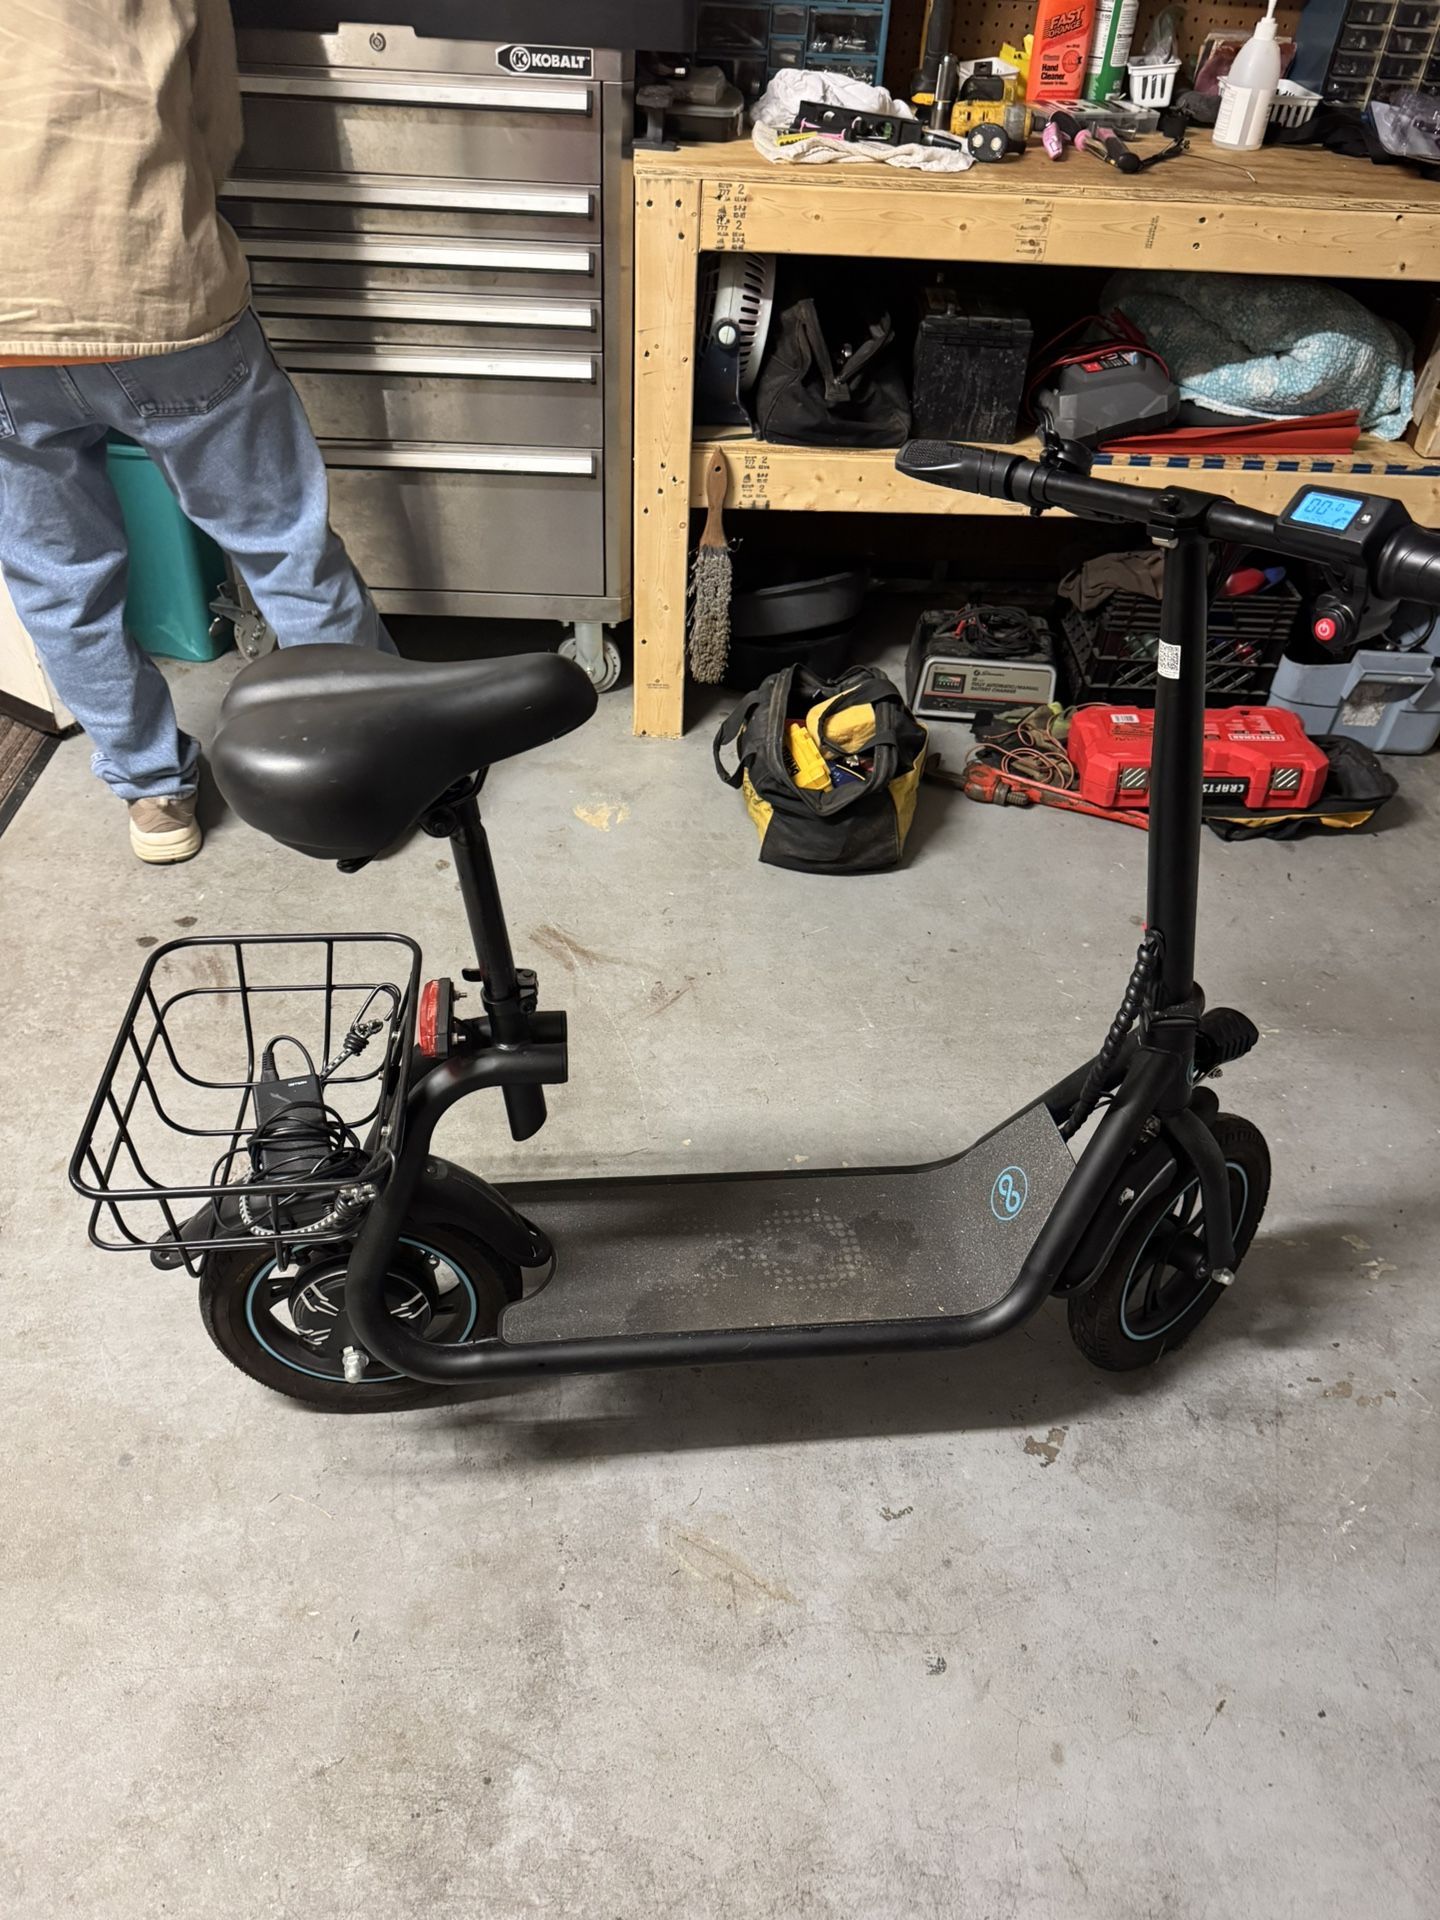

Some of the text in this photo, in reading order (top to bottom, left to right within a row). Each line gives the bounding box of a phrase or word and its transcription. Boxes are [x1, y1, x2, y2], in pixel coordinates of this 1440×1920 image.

[1049, 6, 1085, 30] FAST
[1047, 20, 1083, 38] ORANGE
[531, 53, 585, 69] KOBALT
[1041, 63, 1059, 72] Hand
[1040, 72, 1066, 81] Cleaner
[1201, 783, 1245, 793] CRAFTS
